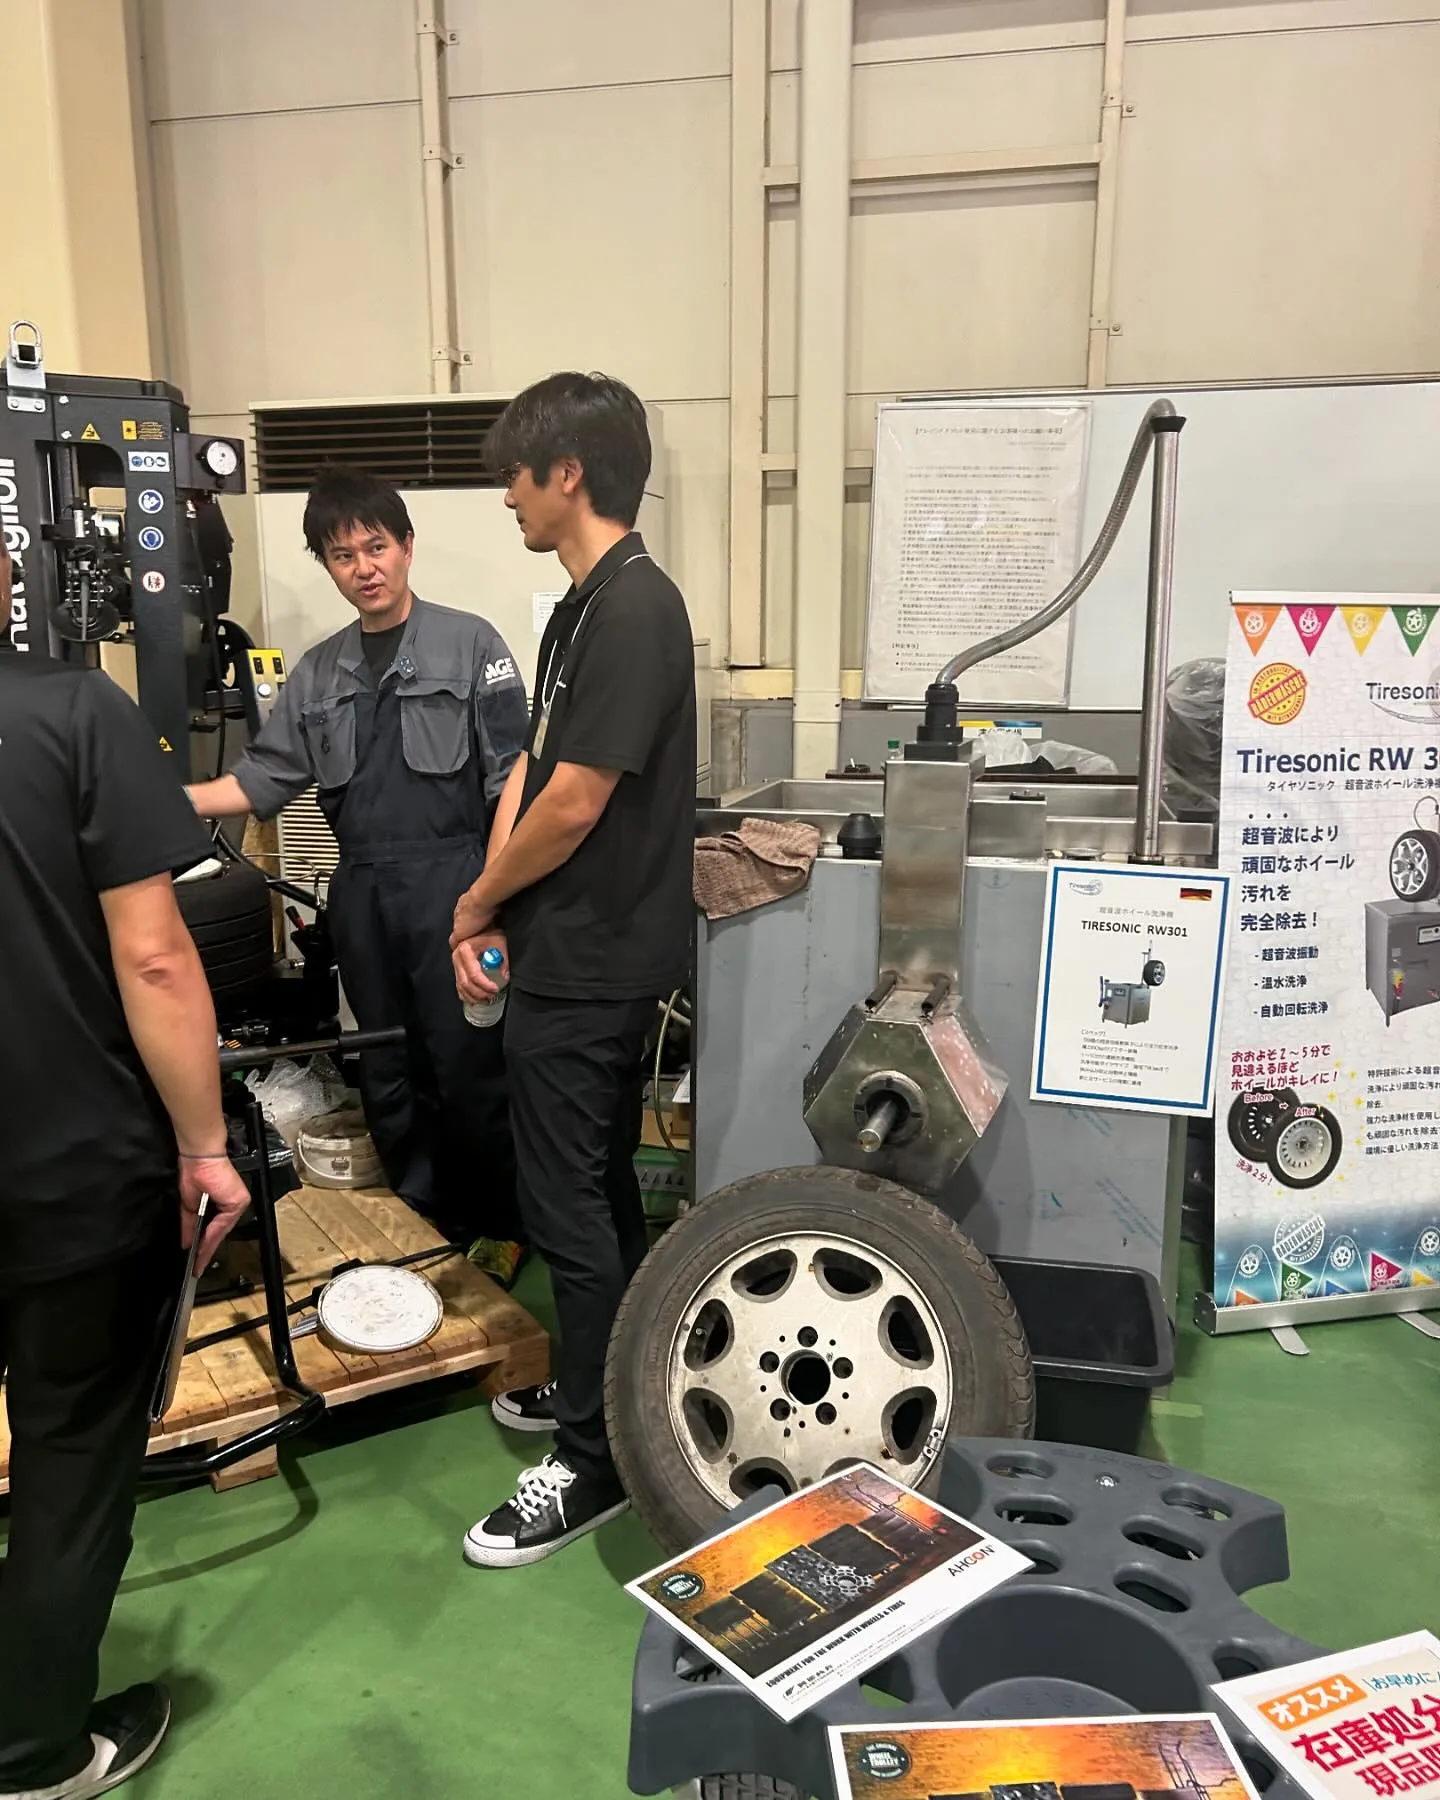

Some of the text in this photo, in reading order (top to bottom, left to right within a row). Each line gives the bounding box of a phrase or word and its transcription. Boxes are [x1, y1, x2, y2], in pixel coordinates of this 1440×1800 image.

[1365, 682, 1440, 700] Tiresoni
[1237, 746, 1440, 773] Tiresonic RW 3
[1267, 779, 1335, 792] タイヤソニック
[1241, 825, 1339, 846] 超音波により
[1241, 853, 1355, 874] 頑固なホイール
[1241, 884, 1292, 903] 汚れを
[1081, 920, 1188, 937] TIRESONIC RW301
[1240, 912, 1317, 931] 完全除去！
[1231, 1061, 1300, 1078] 見違えるほど
[1244, 1093, 1273, 1104] Before
[1295, 1107, 1316, 1118] After
[1366, 1126, 1440, 1140] も頑固な汚れを除去
[948, 1545, 995, 1577] AHCON
[765, 1663, 802, 1687] EQUIPMENT
[801, 1655, 816, 1666] FOR
[813, 1647, 827, 1658] THE
[825, 1637, 846, 1651] WORK
[843, 1627, 863, 1639] WITH
[1372, 1671, 1440, 1689] お早めに
[1269, 1679, 1354, 1724] オススメ
[868, 1752, 891, 1761] WHEEL
[870, 1756, 899, 1767] TROLLEY
